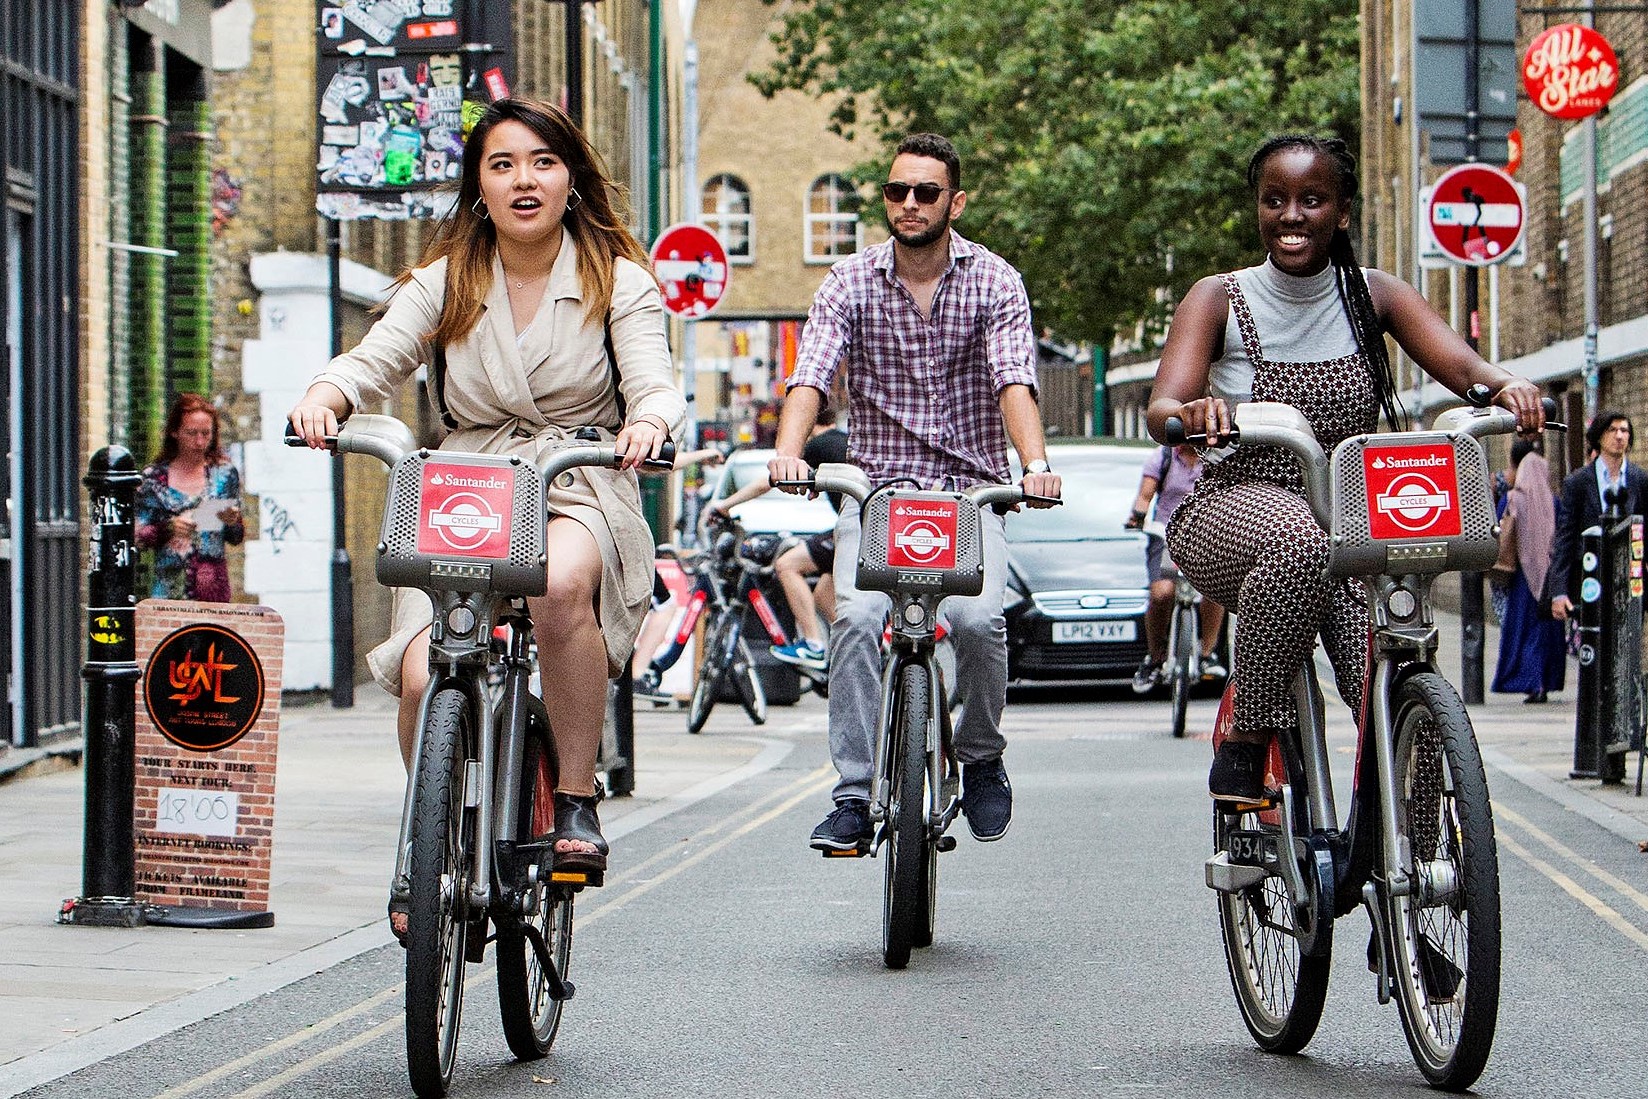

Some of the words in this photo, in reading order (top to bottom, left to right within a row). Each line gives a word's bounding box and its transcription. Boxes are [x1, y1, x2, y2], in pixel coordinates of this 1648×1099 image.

[1526, 26, 1587, 79] All
[1541, 61, 1615, 113] Star
[1386, 453, 1448, 469] Santander
[445, 473, 508, 490] Santander
[1399, 497, 1428, 506] CYCLES
[905, 506, 953, 518] Santander
[451, 516, 480, 526] CYCLES
[1061, 622, 1094, 638] LP12
[1097, 623, 1125, 637] VXY
[142, 757, 172, 768] TOUR
[177, 759, 219, 771] STARTS
[170, 774, 198, 786] NEXT
[138, 834, 193, 848] INTERNET
[137, 883, 167, 894] FROM
